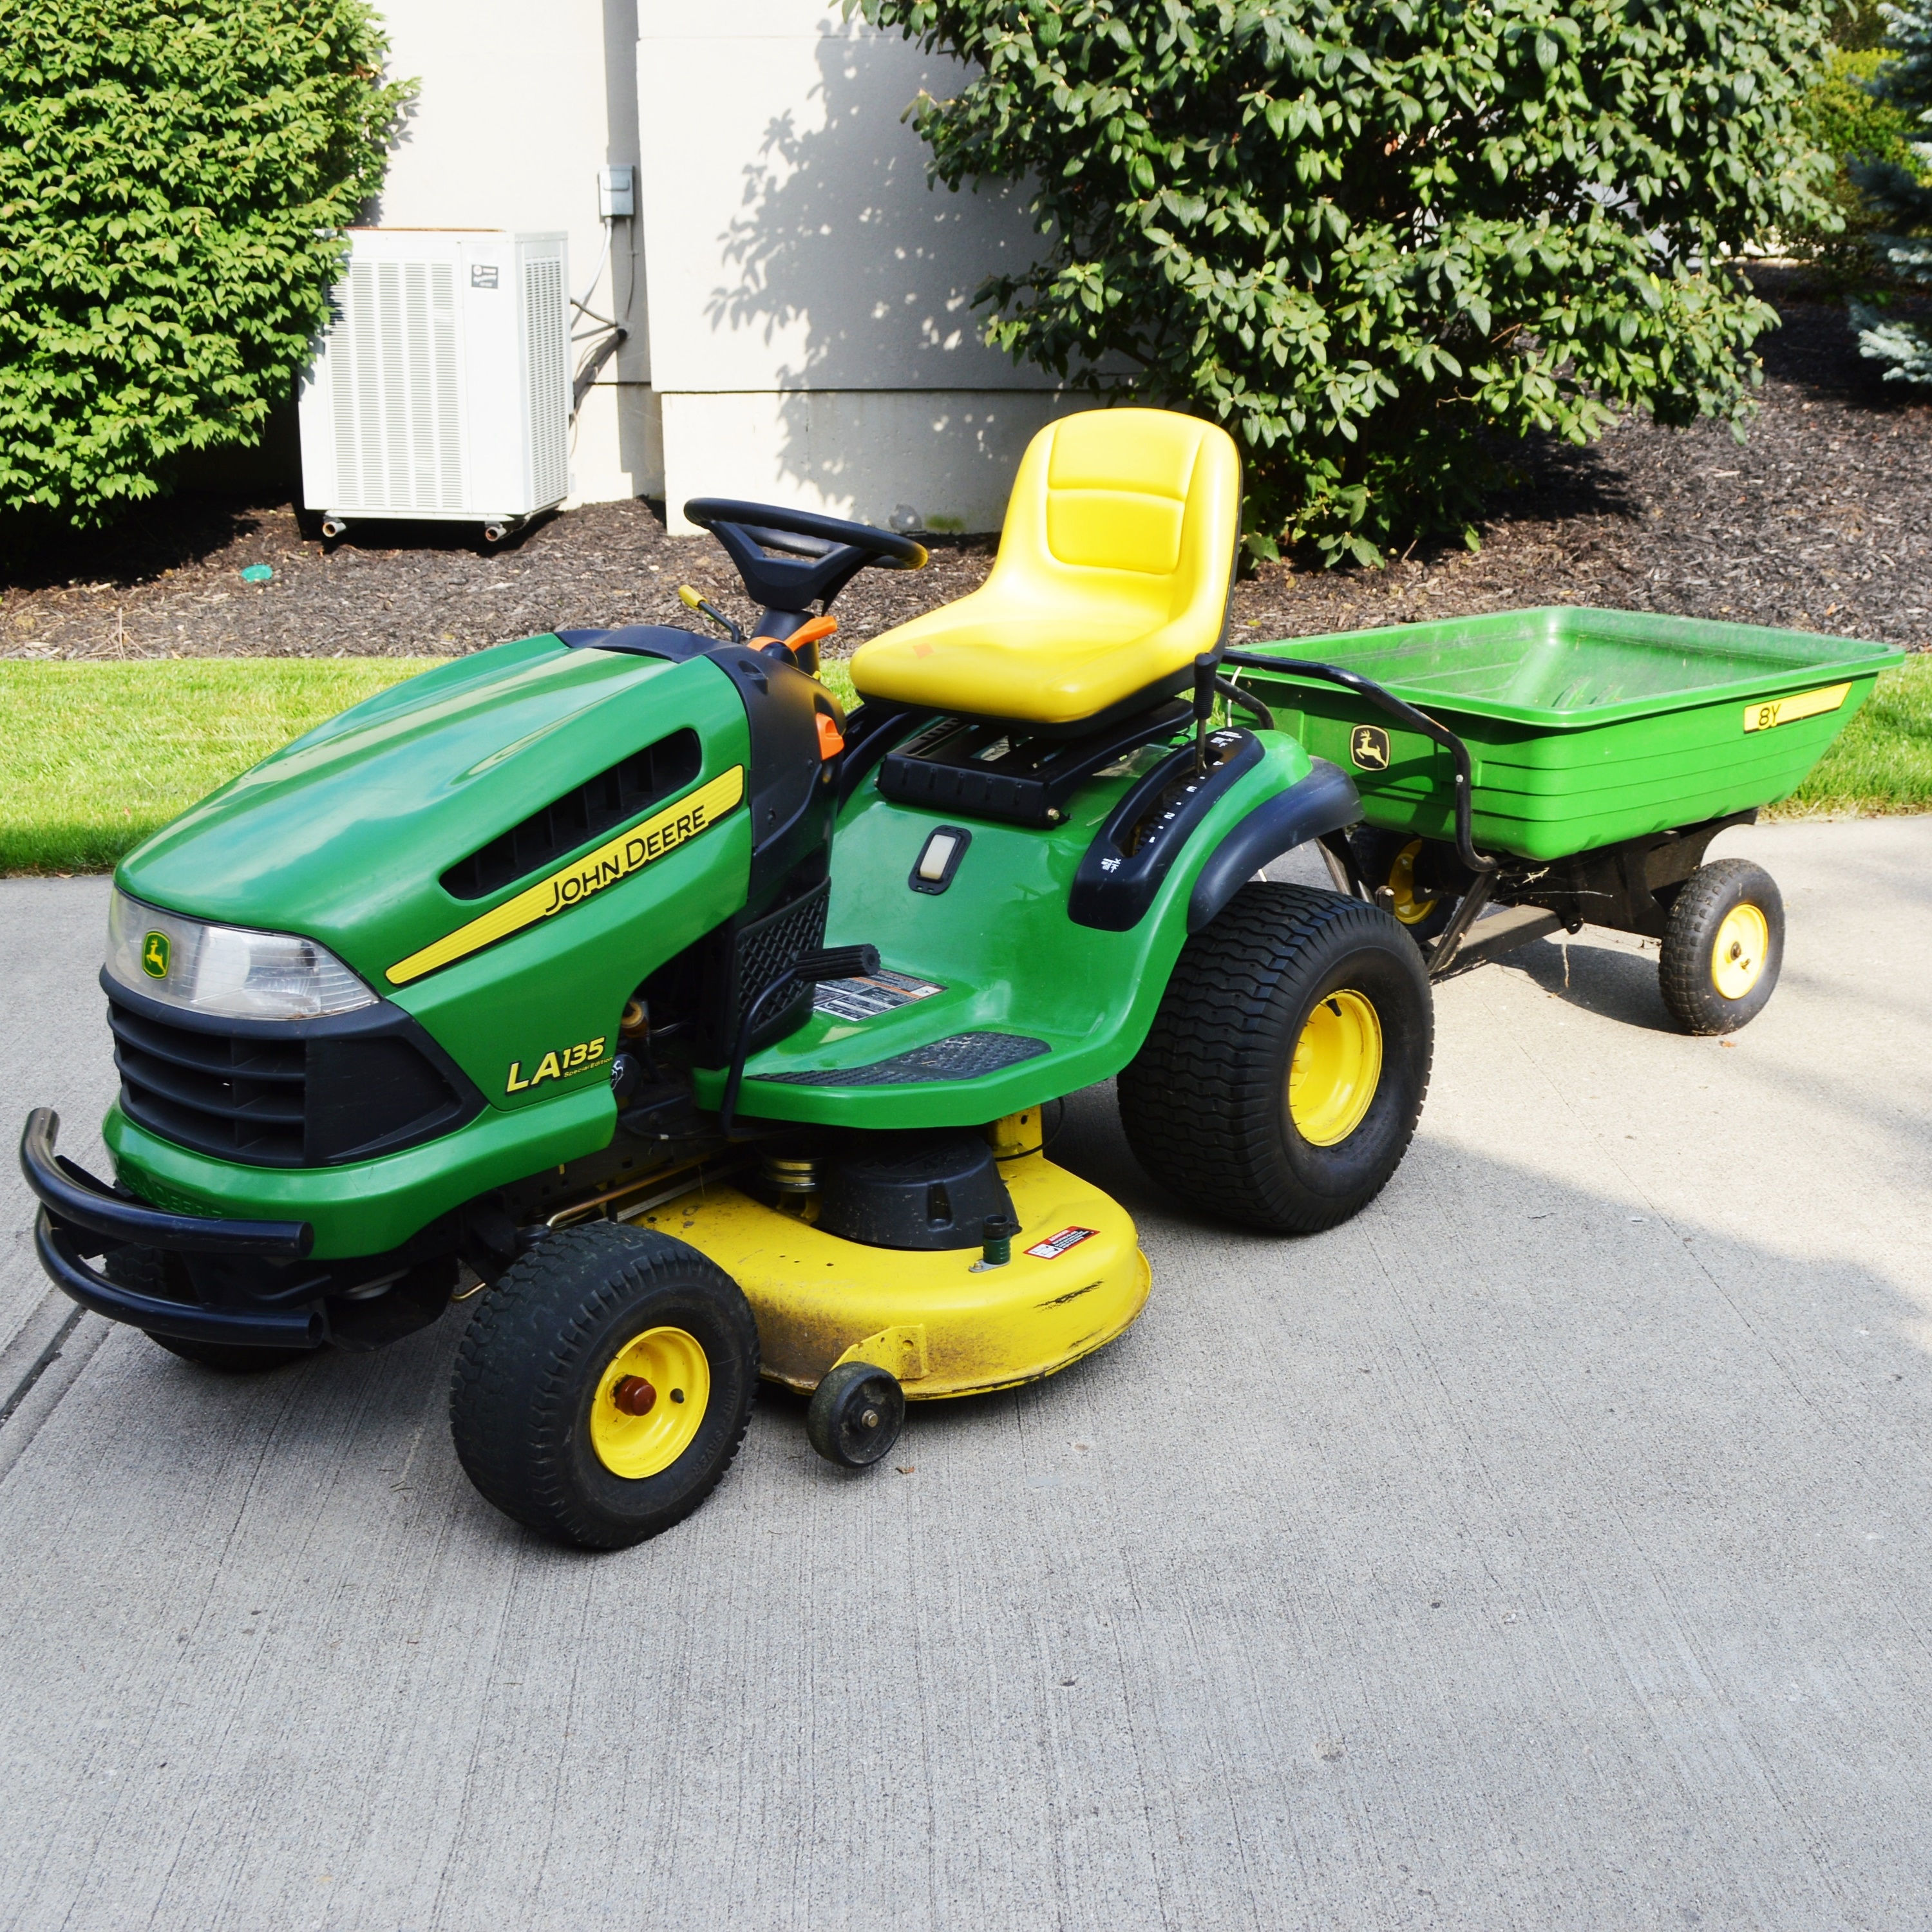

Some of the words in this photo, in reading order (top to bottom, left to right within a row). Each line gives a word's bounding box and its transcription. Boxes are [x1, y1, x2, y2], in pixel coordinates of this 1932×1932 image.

[1759, 703, 1781, 726] 8Y
[545, 855, 620, 913] JOHN
[625, 804, 706, 869] DEERE
[564, 1065, 590, 1077] Special
[590, 1057, 613, 1068] Edition
[692, 1428, 724, 1477] SAVER
